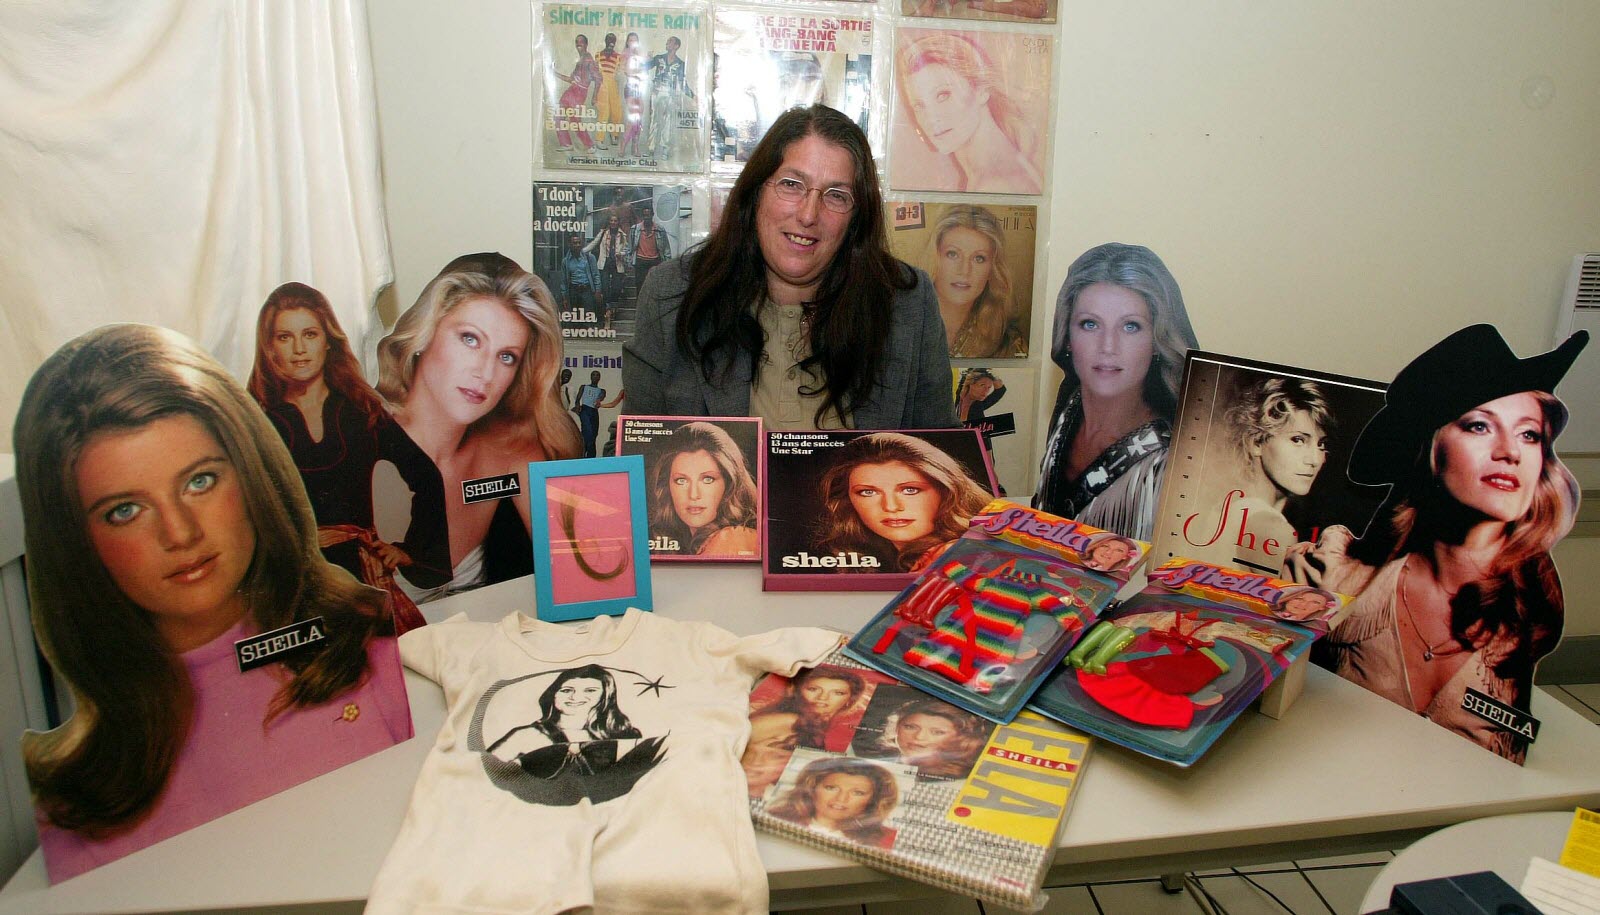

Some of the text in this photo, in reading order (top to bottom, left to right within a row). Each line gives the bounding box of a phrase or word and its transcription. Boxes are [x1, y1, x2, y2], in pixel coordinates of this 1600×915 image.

[628, 12, 657, 29] THE
[779, 17, 796, 28] DE
[801, 18, 817, 29] LA
[822, 18, 871, 32] SORTIE
[757, 27, 837, 41] ANG-BANG
[773, 39, 836, 52] CINEMA
[546, 104, 597, 118] sheila
[639, 159, 658, 167] Club
[538, 187, 583, 202] I don't
[546, 203, 576, 217] need
[533, 217, 588, 232] a doctor
[560, 307, 597, 323] eila
[562, 327, 617, 338] evotion
[625, 420, 664, 428] 50 chansons
[637, 435, 652, 443] Star
[770, 432, 829, 440] 50 chansons
[791, 447, 814, 455] Star
[465, 477, 519, 498] SHEILA
[984, 507, 1092, 554] Sheila
[648, 536, 680, 551] eila
[782, 552, 881, 568] sheila
[1162, 563, 1284, 605] Sheila
[240, 625, 325, 664] SHEILA
[1461, 693, 1535, 740] SHEILA
[995, 749, 1068, 771] SHEILA
